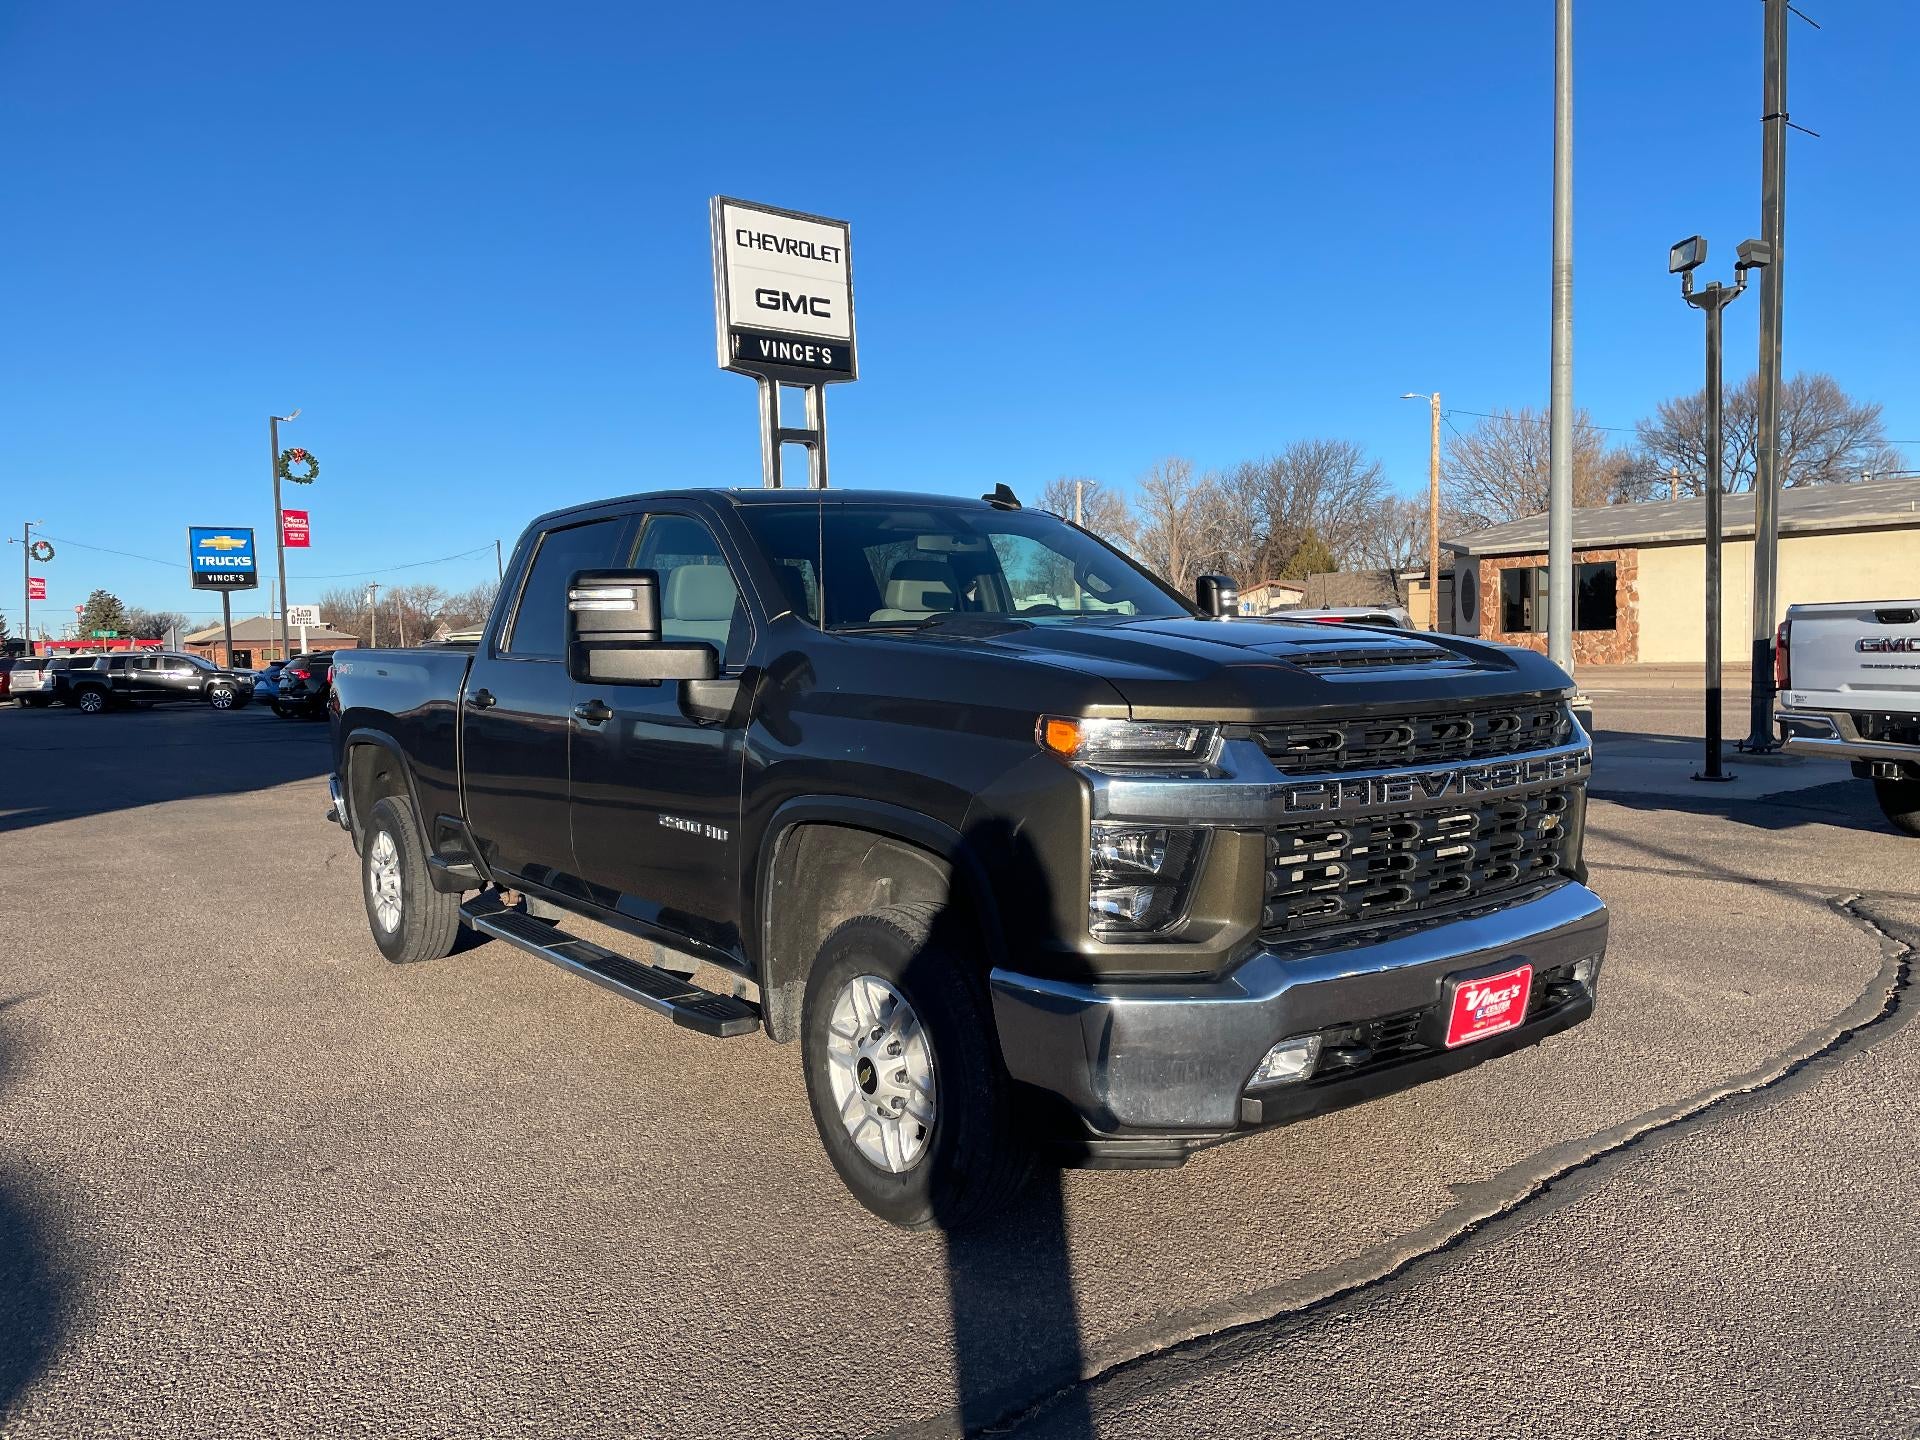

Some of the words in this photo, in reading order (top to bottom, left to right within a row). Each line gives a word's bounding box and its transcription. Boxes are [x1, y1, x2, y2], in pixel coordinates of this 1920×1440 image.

[736, 229, 841, 263] CHEVROLET
[755, 287, 831, 318] GMC
[759, 339, 832, 364] VINCE'S
[197, 556, 251, 566] TRUCKS
[207, 574, 245, 582] VINCE'S
[1859, 637, 1920, 653] GMC
[1283, 751, 1591, 814] CHEVROLET
[1465, 985, 1521, 1011] VINCE'S
